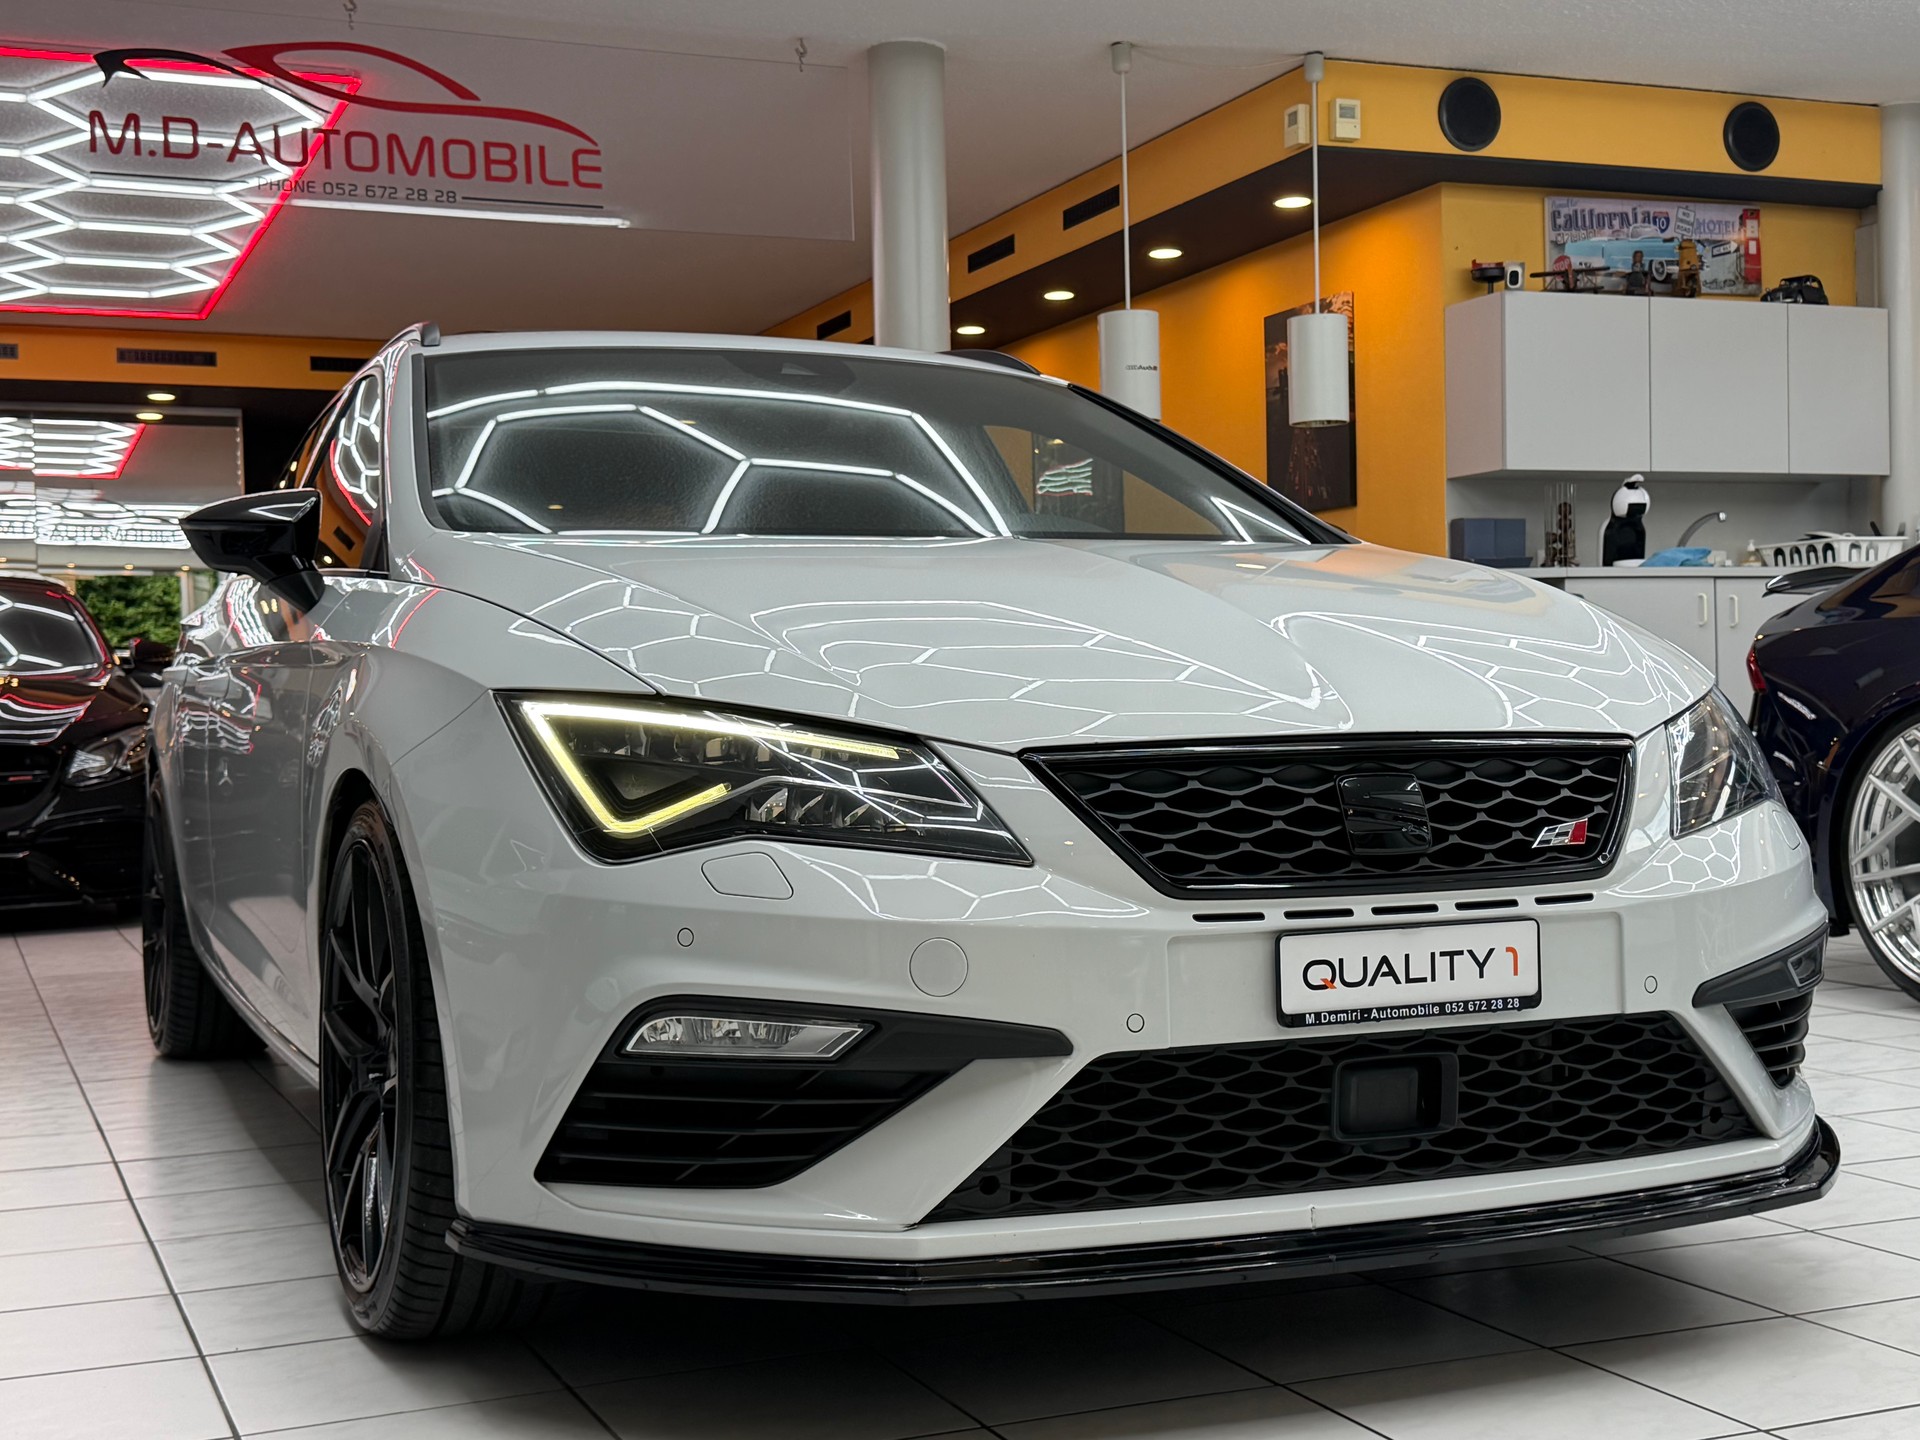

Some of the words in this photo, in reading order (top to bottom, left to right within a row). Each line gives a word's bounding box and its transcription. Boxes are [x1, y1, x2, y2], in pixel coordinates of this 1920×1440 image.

[88, 109, 604, 190] M.D-AUTOMOBILE
[257, 176, 317, 194] PHONE
[322, 181, 358, 197] 052
[365, 184, 398, 200] 672
[405, 187, 428, 202] 28
[434, 189, 457, 204] 28
[1551, 207, 1651, 232] California
[1655, 218, 1667, 230] 10
[1302, 948, 1496, 991] QUALITY
[1505, 946, 1519, 977] 1
[1445, 1002, 1465, 1013] 052
[1468, 1000, 1487, 1012] 672
[1491, 999, 1504, 1010] 28
[1507, 997, 1520, 1008] 28
